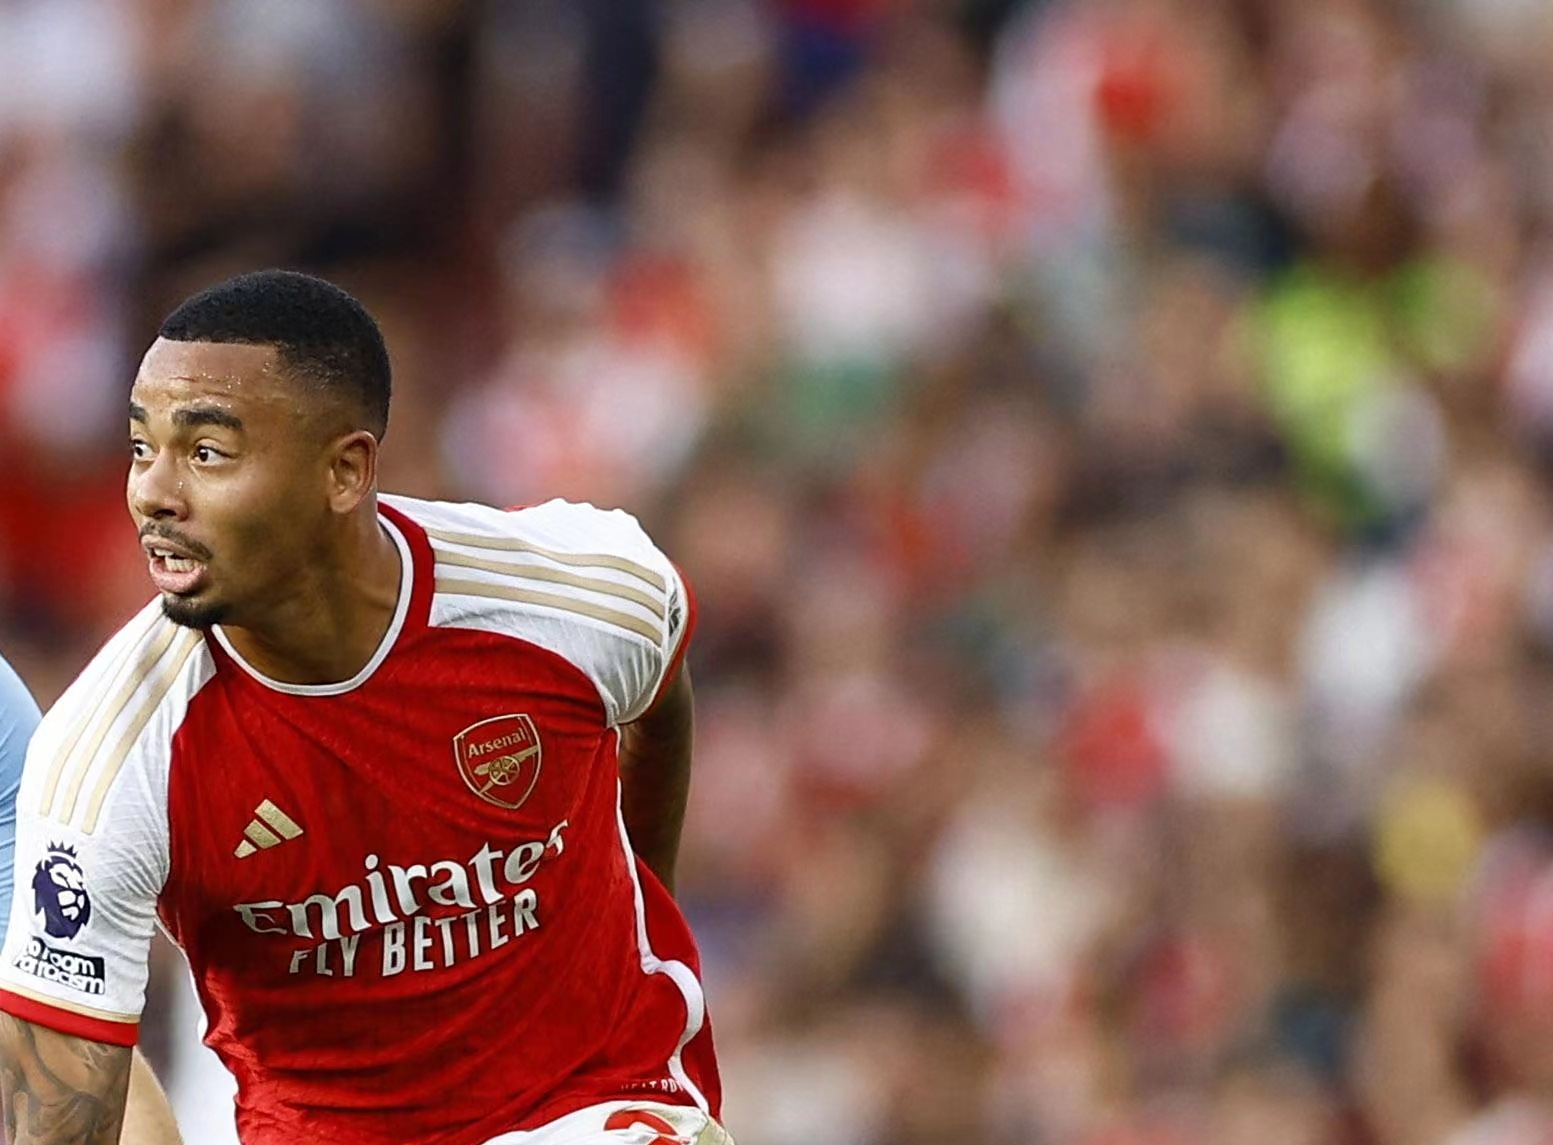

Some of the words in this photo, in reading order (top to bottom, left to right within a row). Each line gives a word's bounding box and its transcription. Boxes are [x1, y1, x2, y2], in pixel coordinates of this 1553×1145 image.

[468, 727, 527, 759] Arsenal
[289, 933, 361, 977] FLY
[382, 888, 540, 977] BETTER
